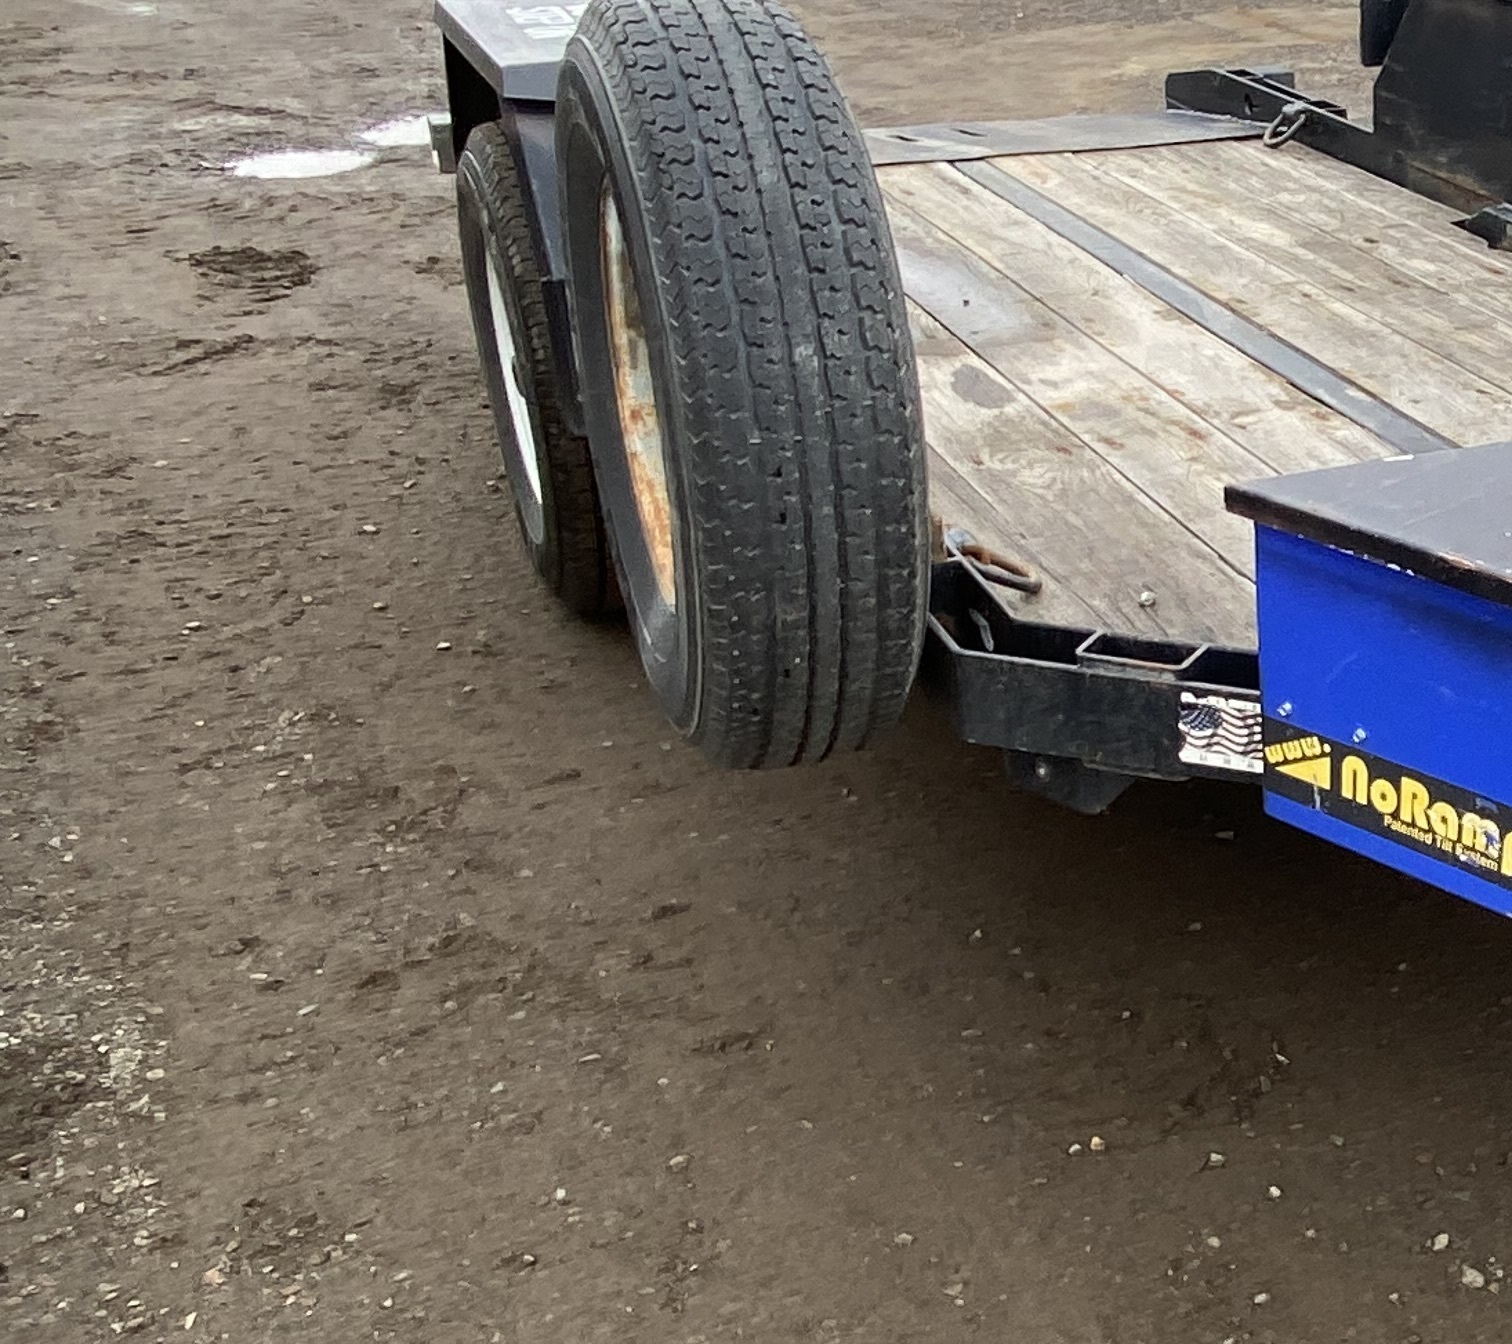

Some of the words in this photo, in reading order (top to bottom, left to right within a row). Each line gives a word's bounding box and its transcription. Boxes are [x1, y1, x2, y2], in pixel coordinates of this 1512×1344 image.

[1263, 735, 1332, 764] www.
[1383, 813, 1433, 846] Patented
[1434, 834, 1454, 856] Tilt
